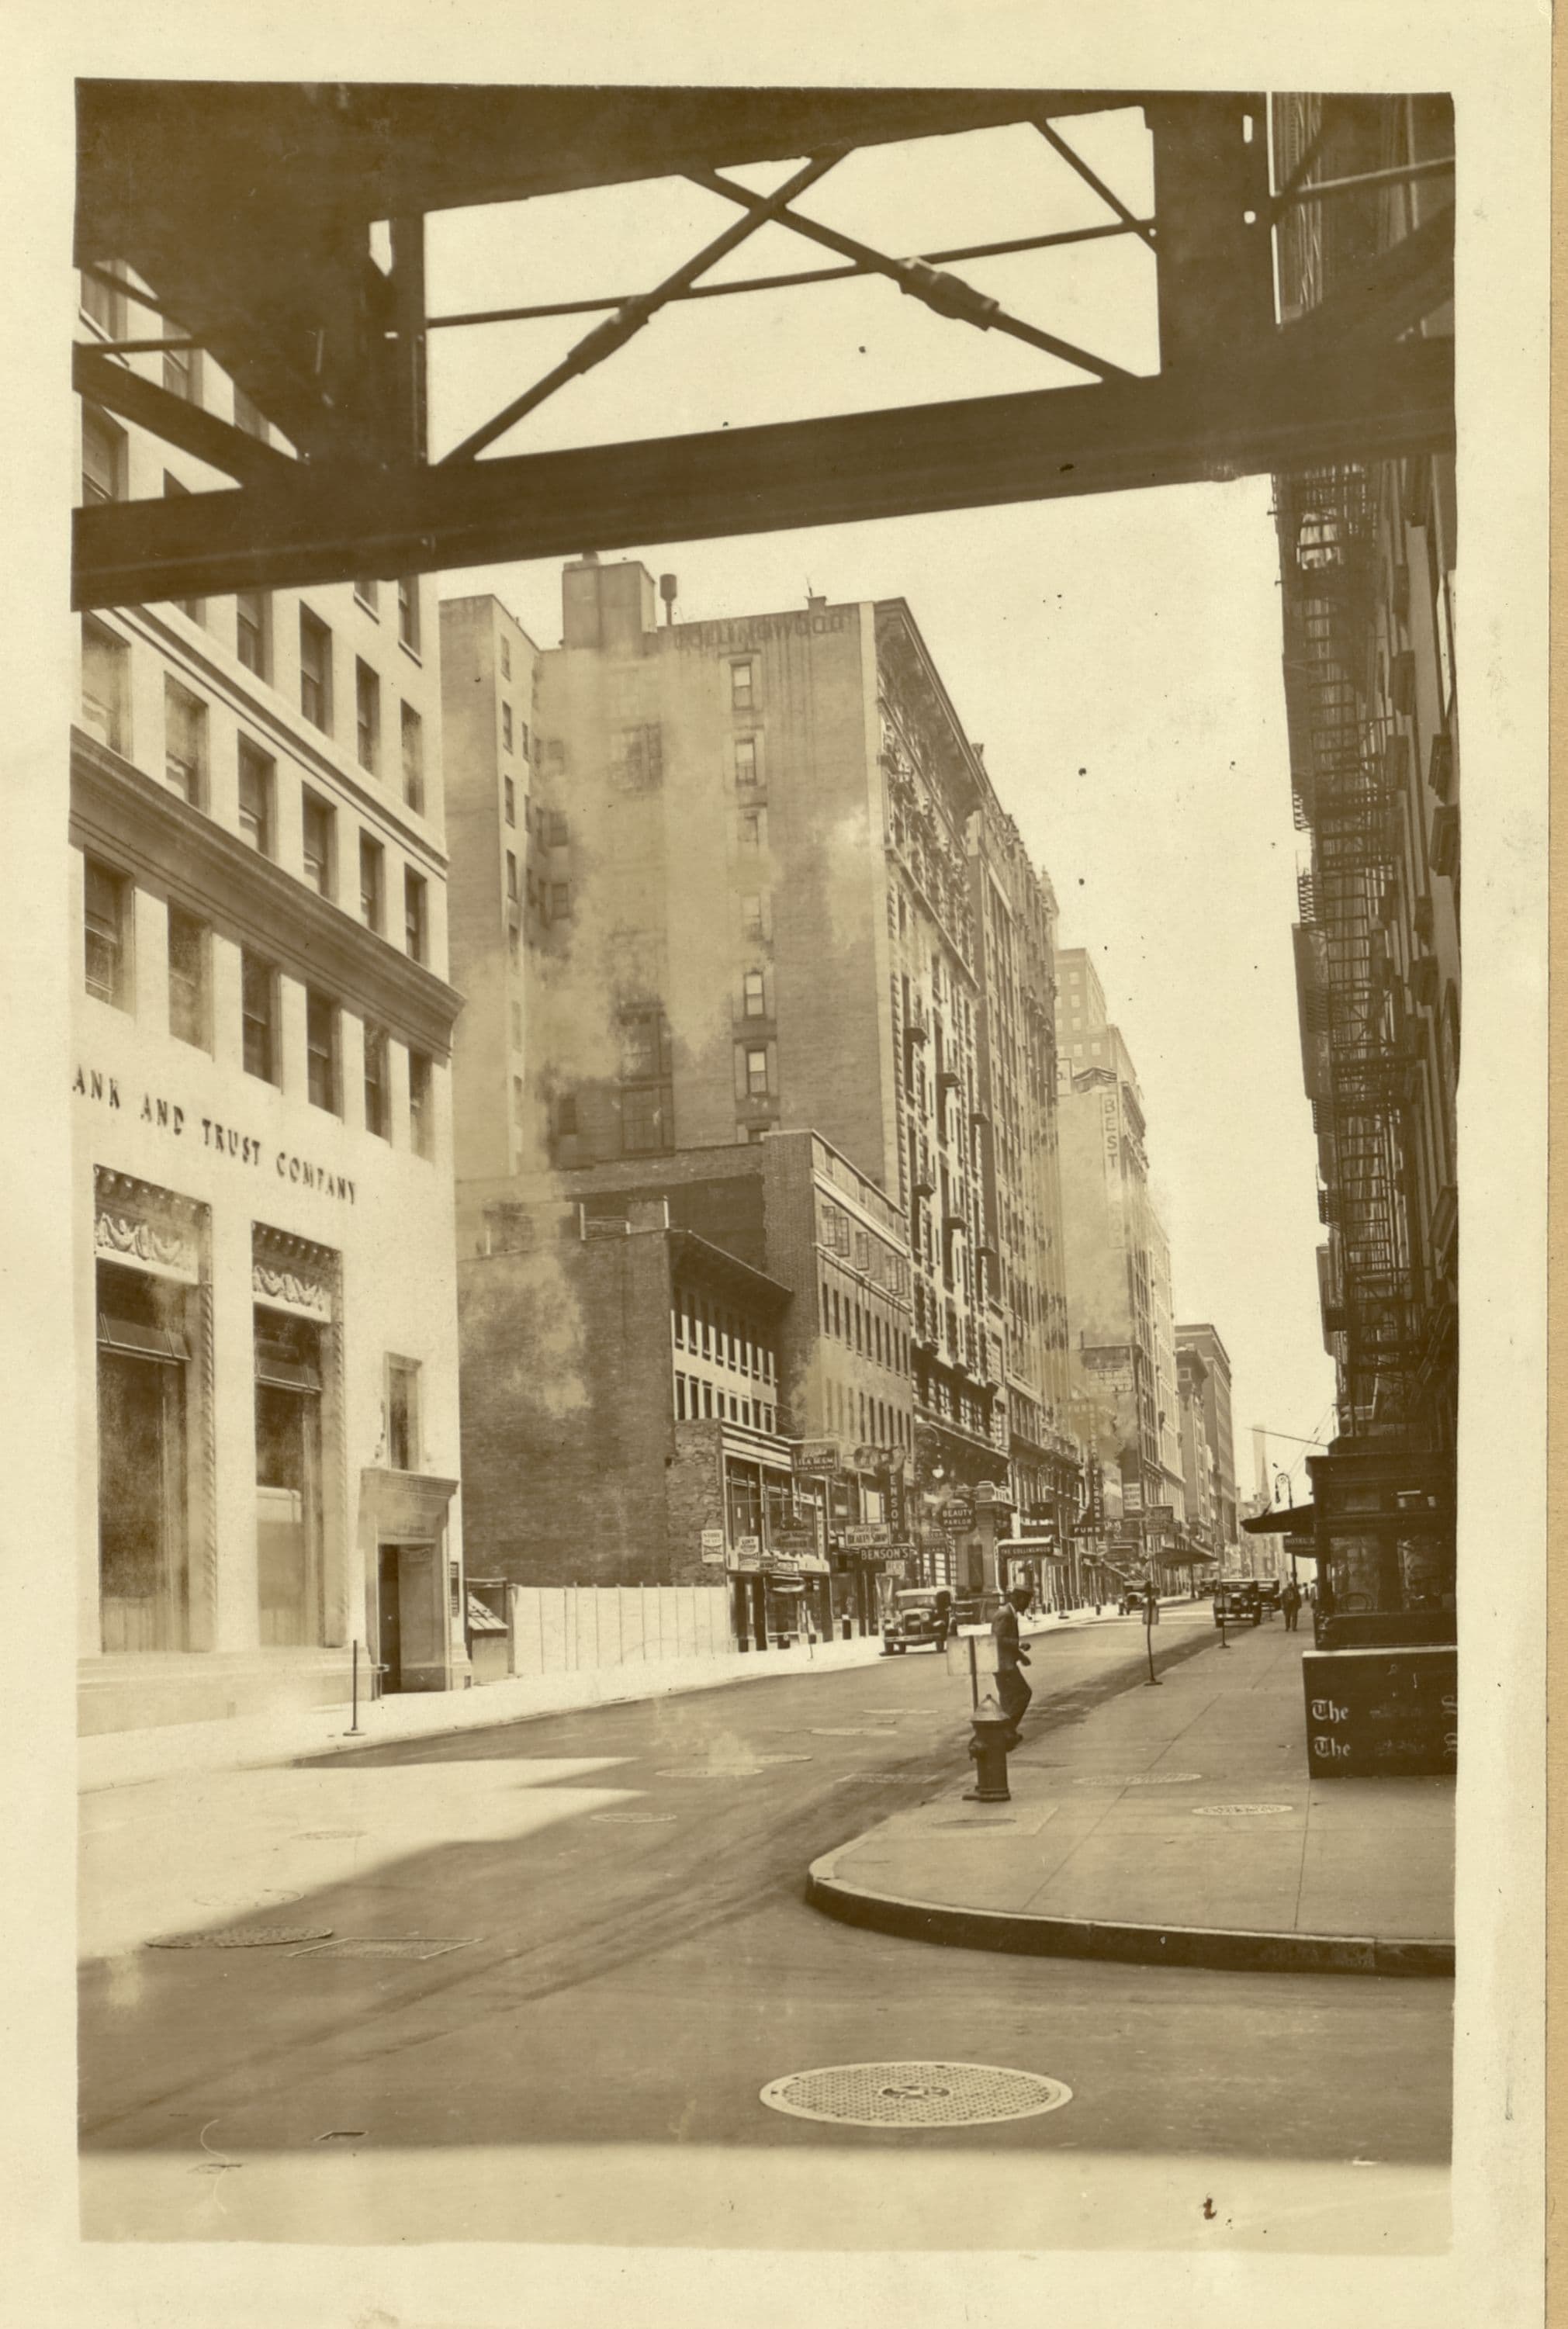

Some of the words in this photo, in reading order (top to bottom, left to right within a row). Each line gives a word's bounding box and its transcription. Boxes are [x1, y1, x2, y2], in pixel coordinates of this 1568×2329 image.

[1103, 1098, 1118, 1168] BEST
[140, 1092, 184, 1136] AND
[202, 1117, 261, 1166] TRUST
[275, 1151, 356, 1205] COMPANY
[943, 1509, 972, 1517] BEAUTY
[860, 1547, 909, 1561] BENSON'S
[1312, 1698, 1350, 1723] The
[1314, 1735, 1352, 1759] The
